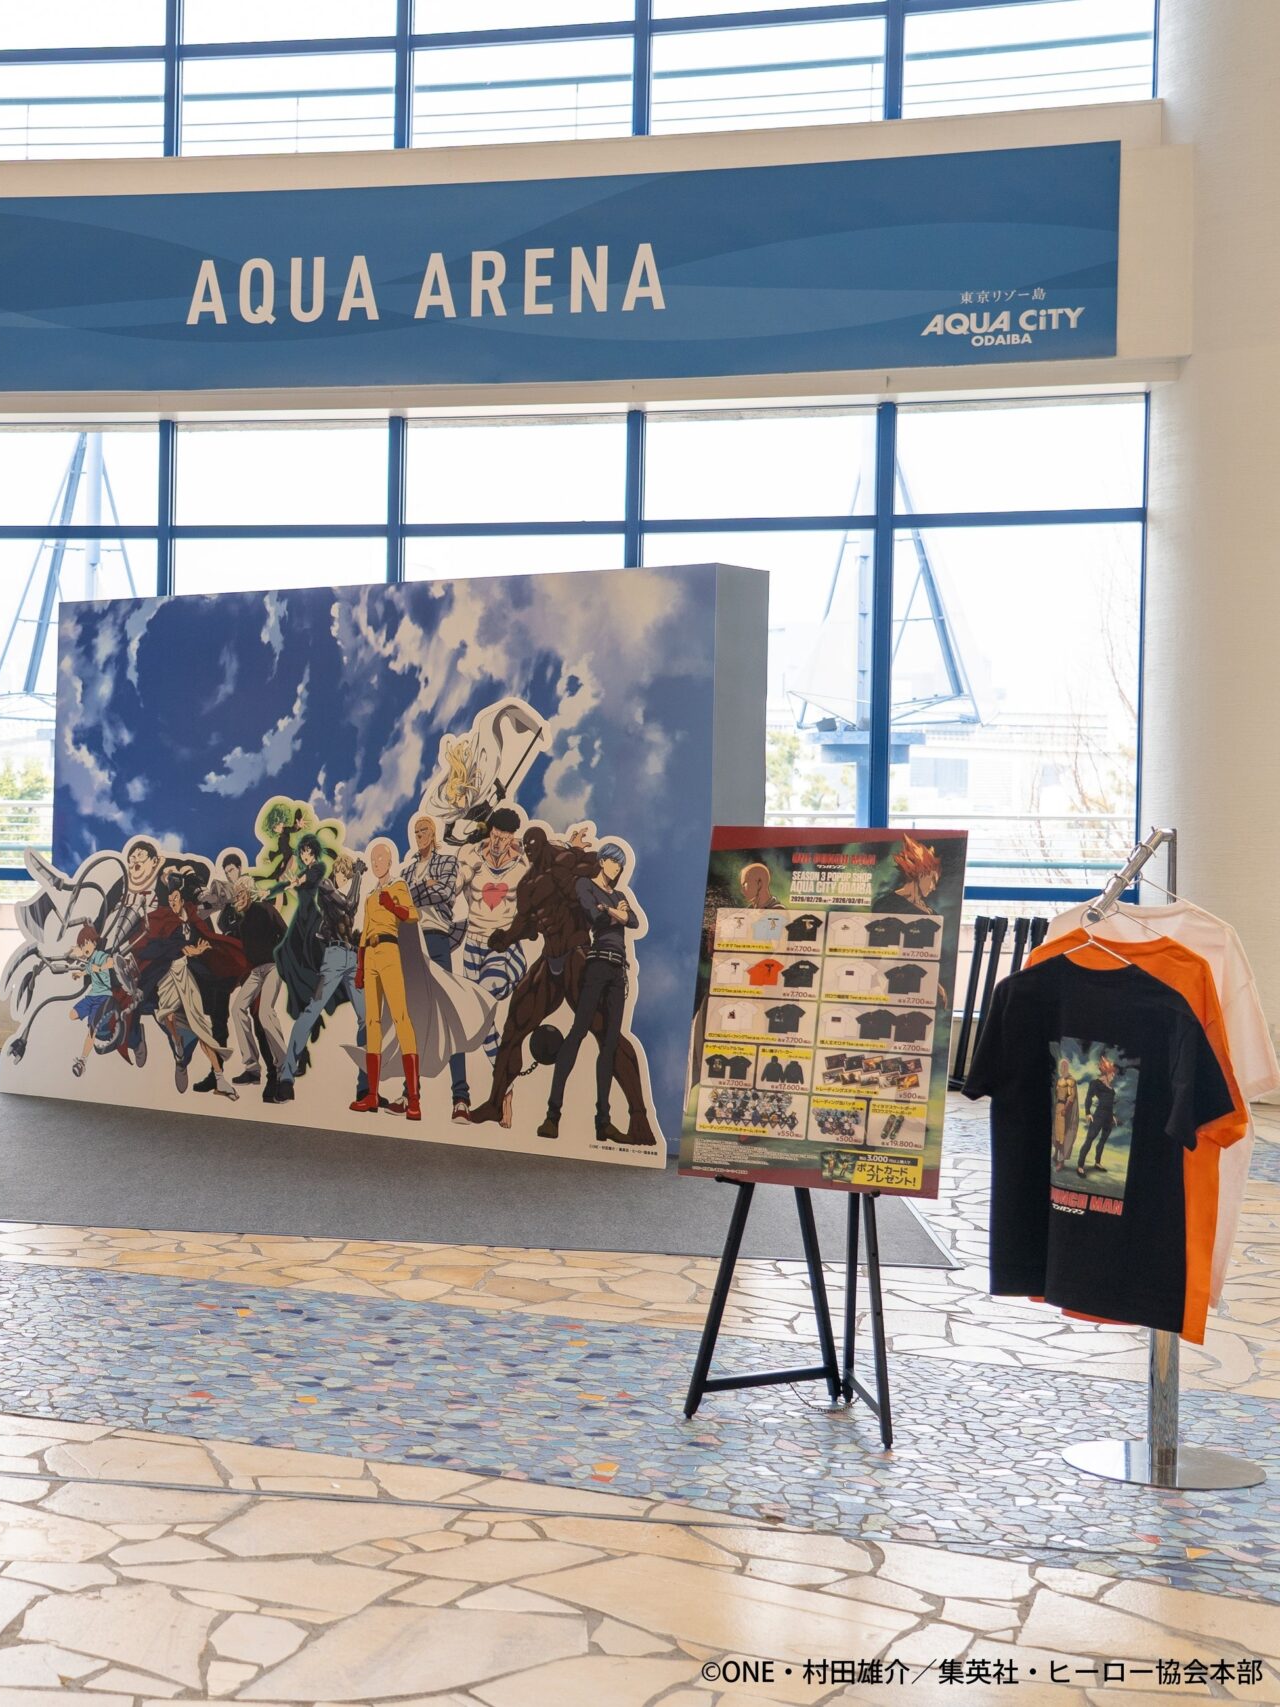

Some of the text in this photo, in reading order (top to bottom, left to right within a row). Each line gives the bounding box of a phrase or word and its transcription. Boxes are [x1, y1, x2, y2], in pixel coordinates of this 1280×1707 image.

[186, 243, 666, 324] AQUA ARENA
[960, 287, 1047, 304] 東京リゾー島
[921, 311, 1010, 335] AQUA
[971, 333, 1032, 347] ODAIBA
[792, 871, 872, 882] SEASON 3 POPUP SHOP
[790, 881, 814, 894] AQUA
[816, 882, 837, 893] CITY
[857, 1163, 908, 1175] ポストカード
[867, 1174, 916, 1186] プレゼント!
[1090, 1195, 1123, 1216] MAN
